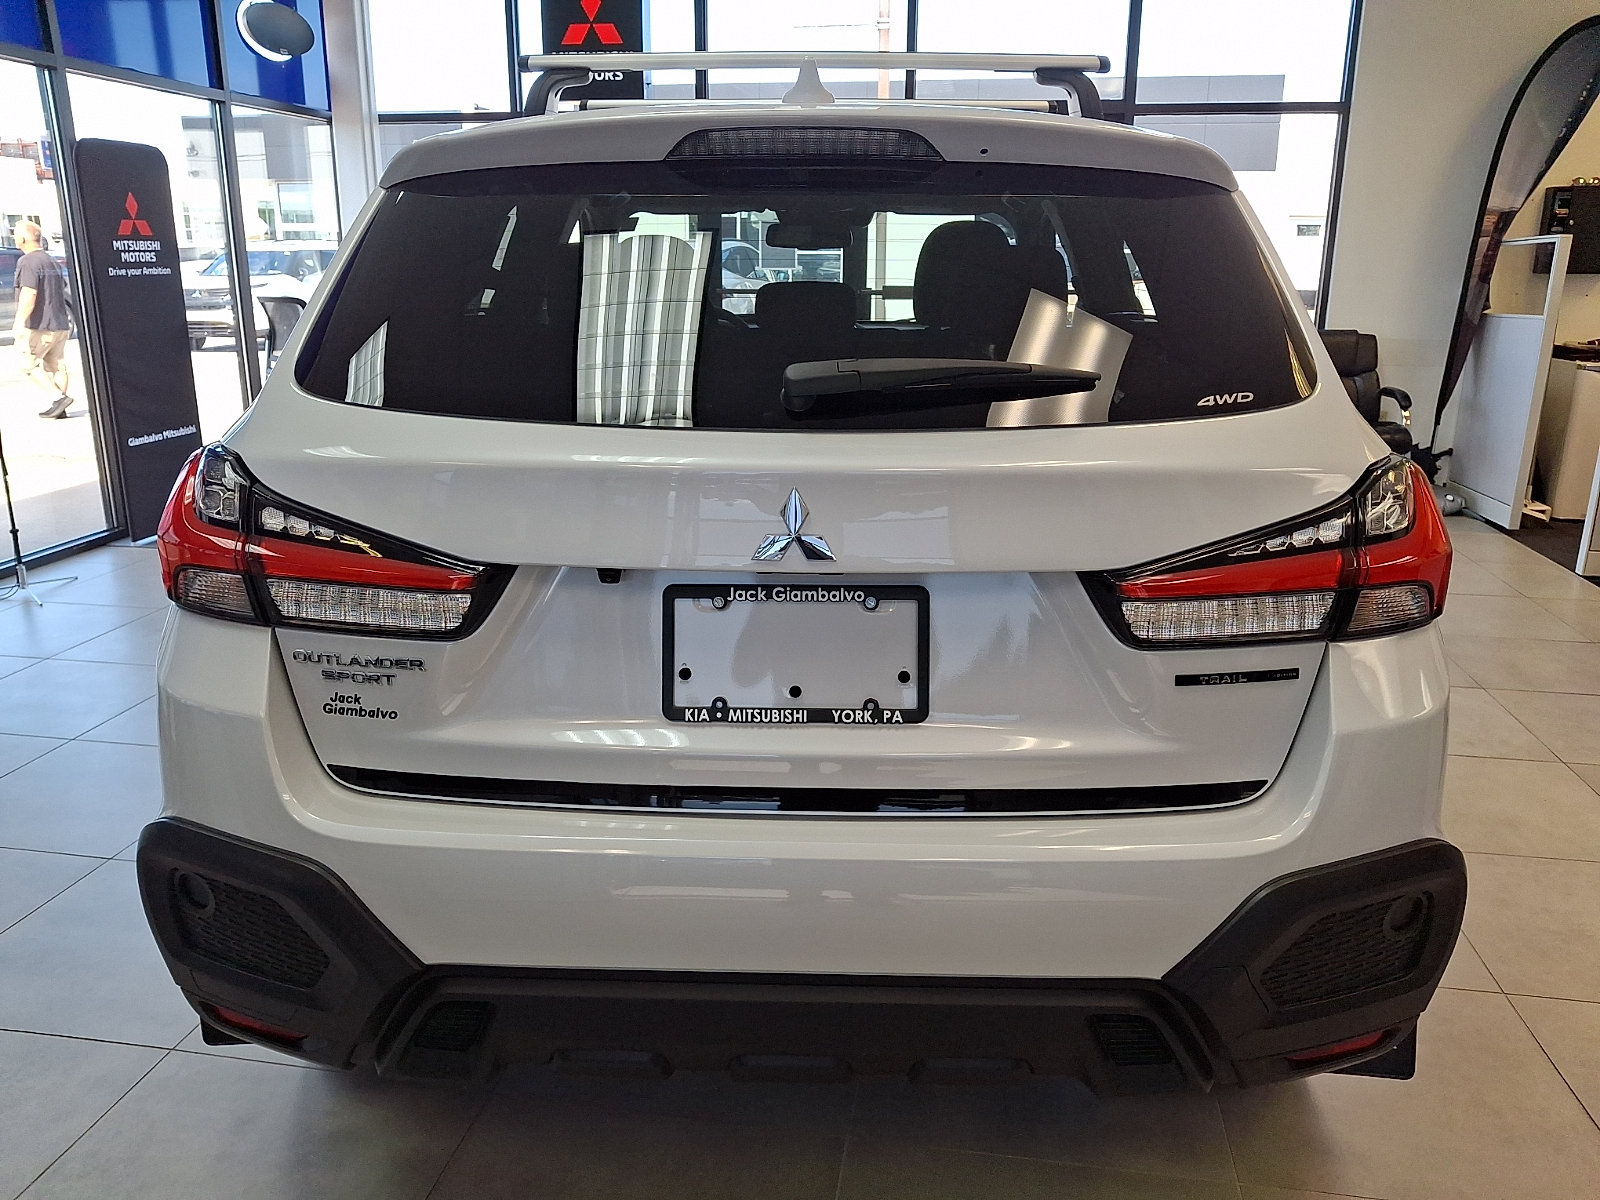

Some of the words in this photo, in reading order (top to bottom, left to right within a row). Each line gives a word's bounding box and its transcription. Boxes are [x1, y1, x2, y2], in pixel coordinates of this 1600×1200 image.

[112, 240, 161, 251] MITSUBISHI
[120, 252, 157, 263] MOTORS
[108, 267, 127, 276] Drive
[127, 268, 142, 277] your
[142, 266, 172, 275] Ambition
[1196, 392, 1254, 406] 4WD
[127, 433, 163, 447] Giambalvo
[162, 424, 197, 440] Mitsubishi
[727, 587, 768, 602] Jack
[772, 587, 865, 602] Giambalvo
[292, 649, 427, 671] OUTLANDER
[321, 669, 397, 686] SPORT
[1199, 674, 1248, 685] TRAIL
[329, 691, 362, 706] Jack
[322, 702, 399, 720] Giambalvo
[684, 708, 710, 722] KIA
[727, 709, 808, 723] MITSUBISHI
[831, 709, 879, 724] YORK,
[882, 710, 904, 724] PA
